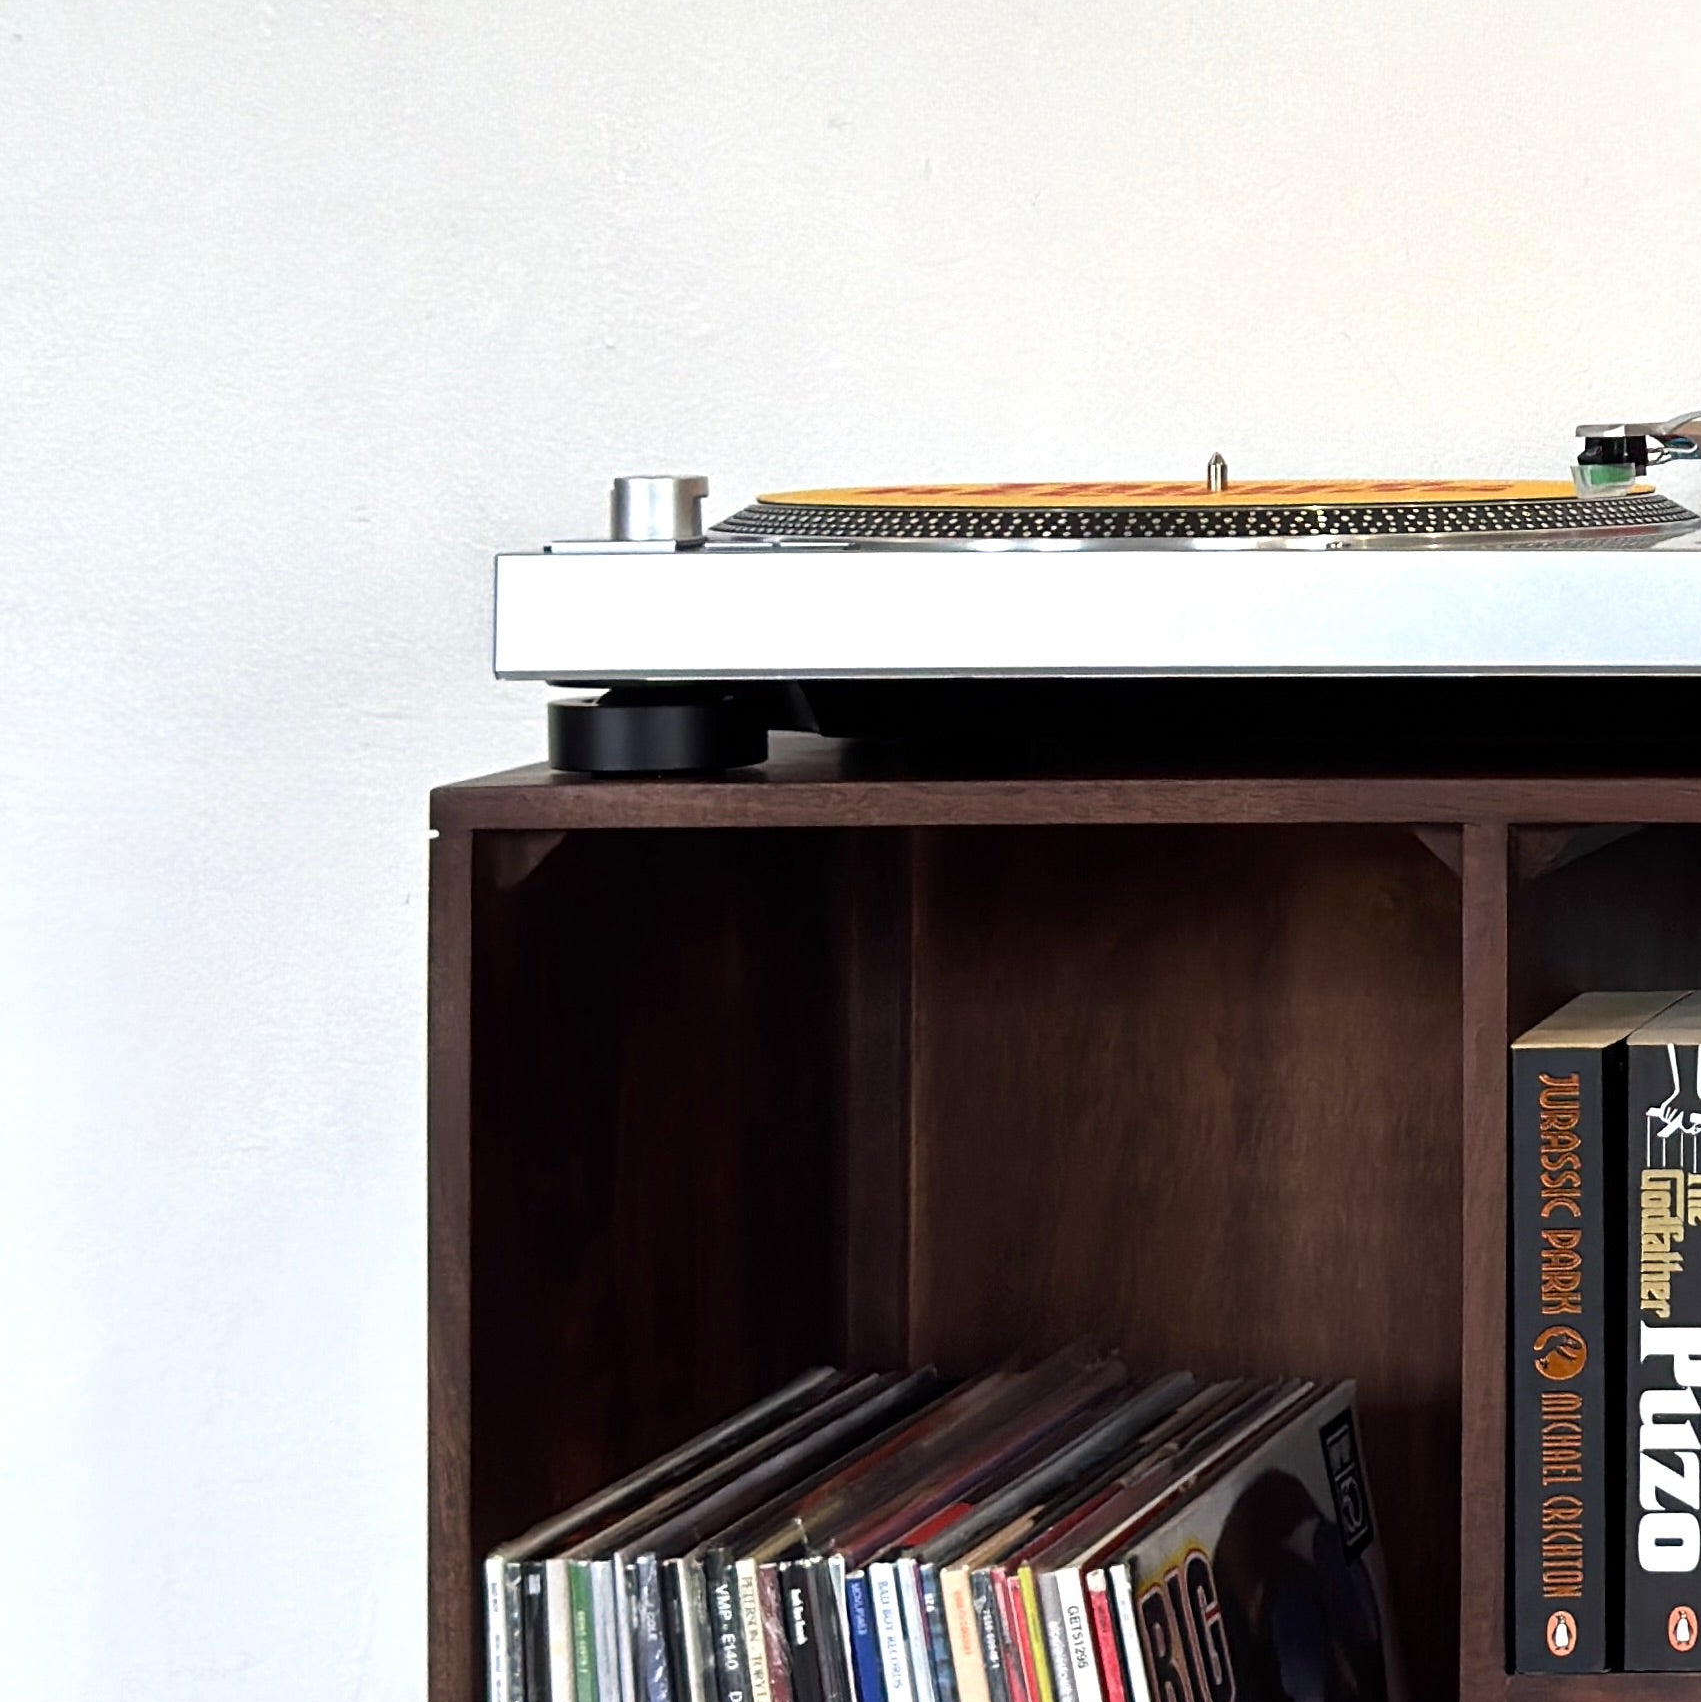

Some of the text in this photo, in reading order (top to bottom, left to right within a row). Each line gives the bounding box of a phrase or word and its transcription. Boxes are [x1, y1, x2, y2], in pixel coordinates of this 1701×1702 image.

[1539, 1072, 1583, 1315] JURASSIC PARK
[1641, 1169, 1684, 1319] Godfather
[1542, 1393, 1583, 1599] MICHAEL CRICHTON
[714, 1584, 731, 1620] VMP
[721, 1633, 738, 1670] E140
